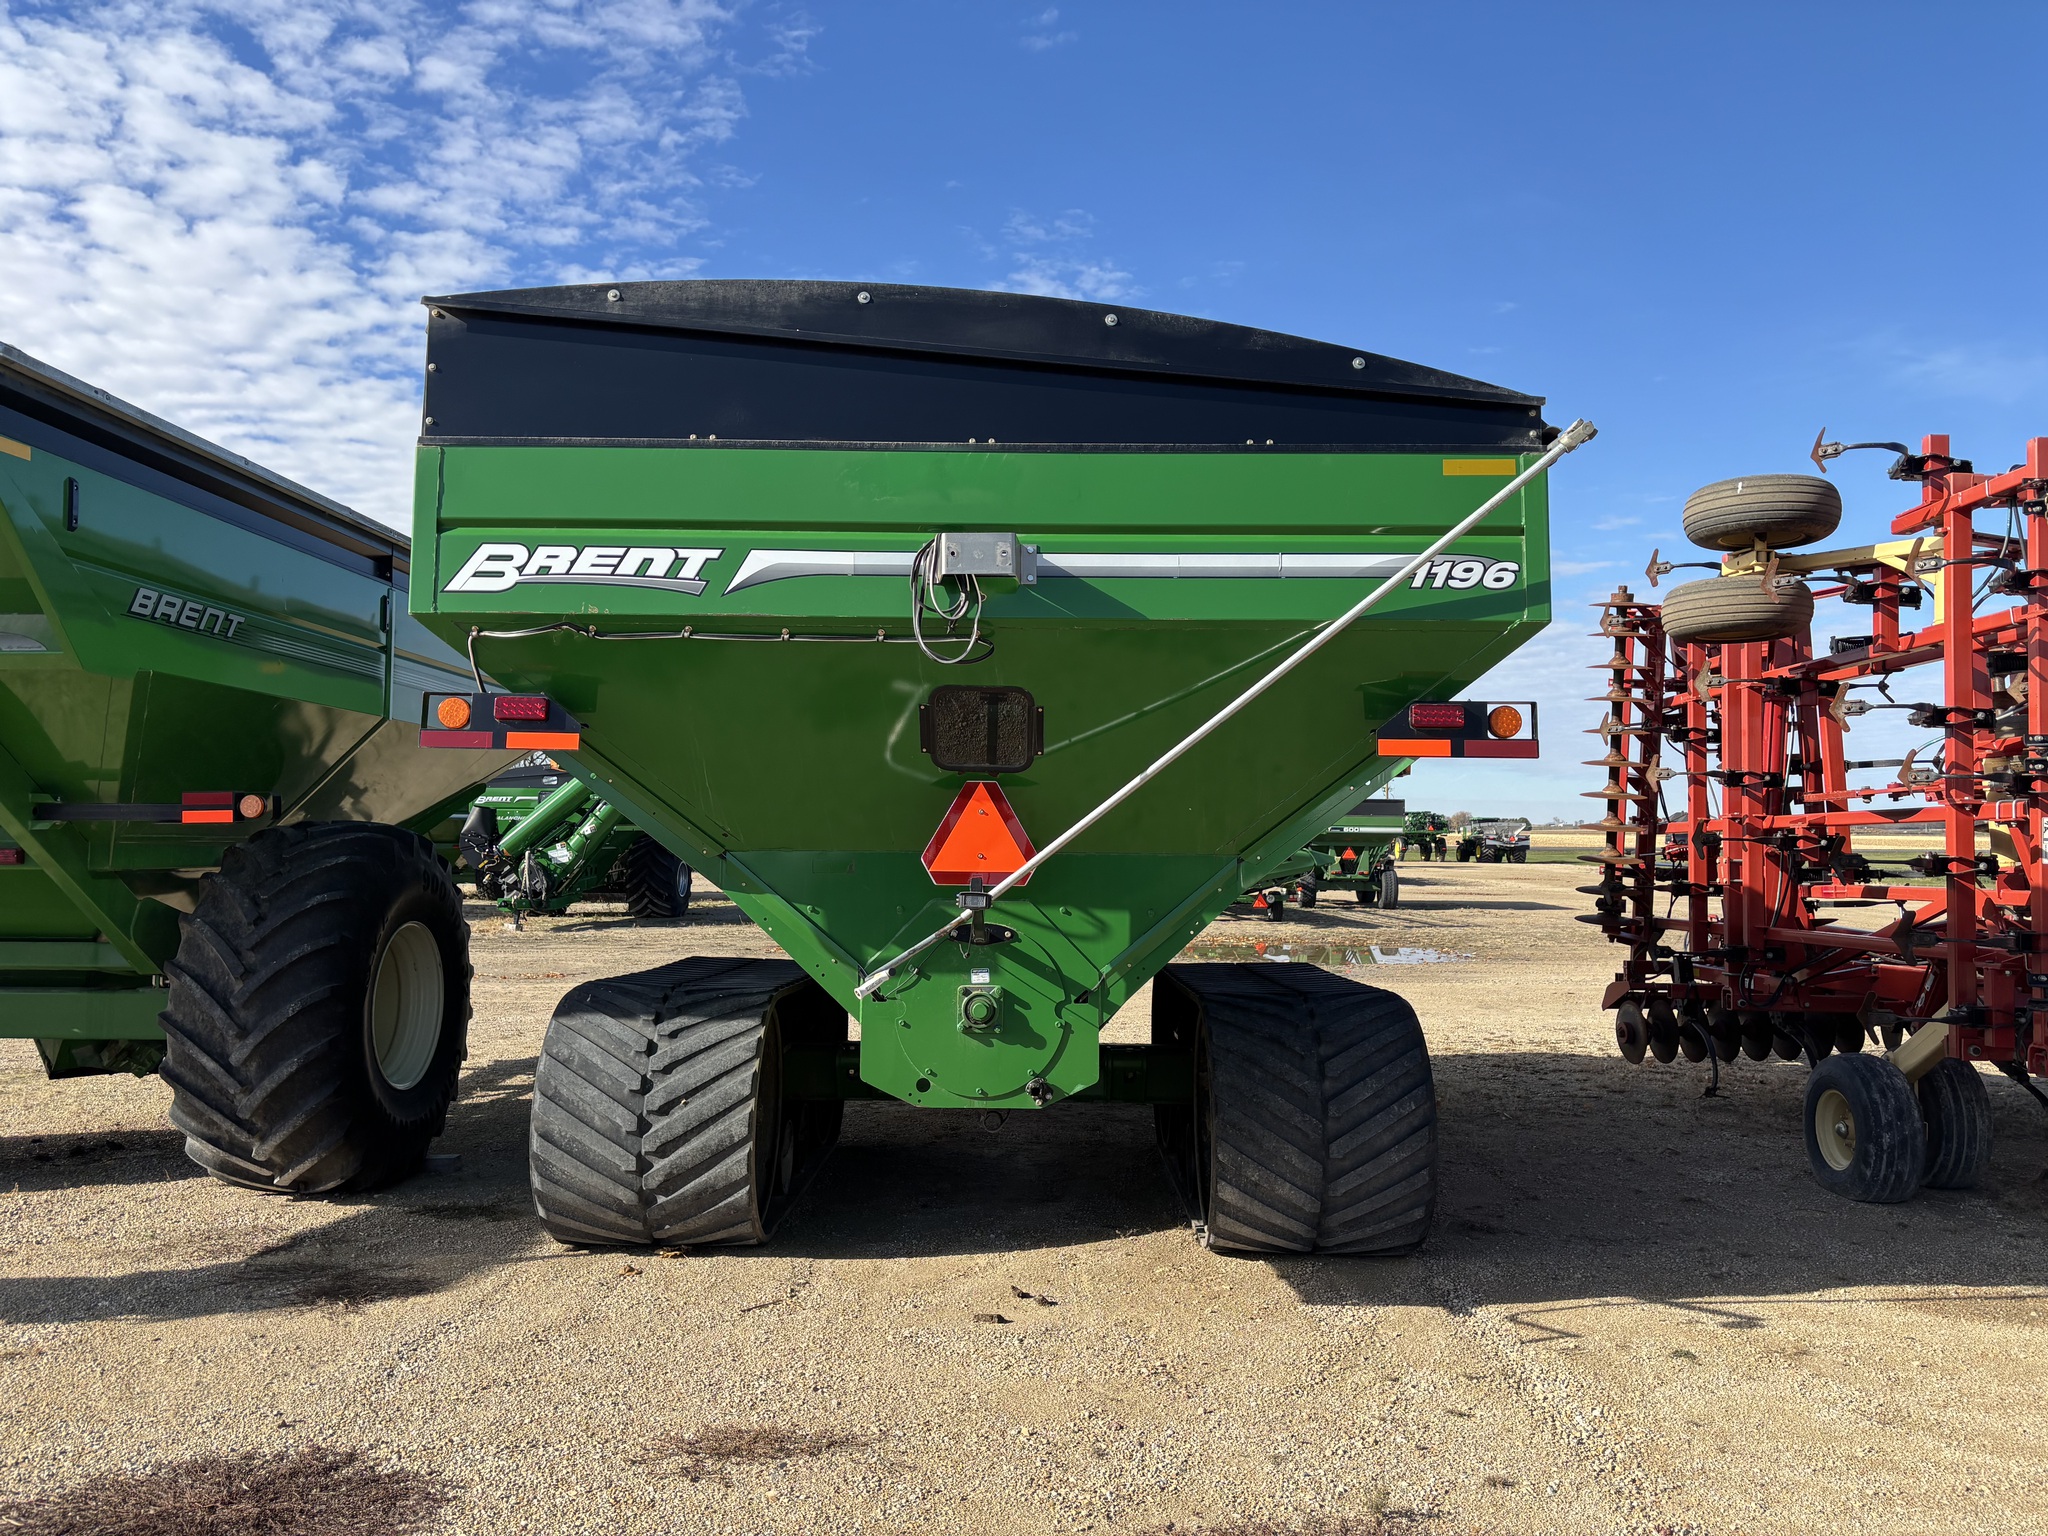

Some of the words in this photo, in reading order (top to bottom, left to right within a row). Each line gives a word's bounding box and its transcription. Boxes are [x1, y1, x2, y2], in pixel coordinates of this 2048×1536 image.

[442, 542, 726, 593] BRENT
[1409, 560, 1520, 591] 1196
[128, 587, 246, 639] BRENT
[474, 795, 514, 805] BRENT
